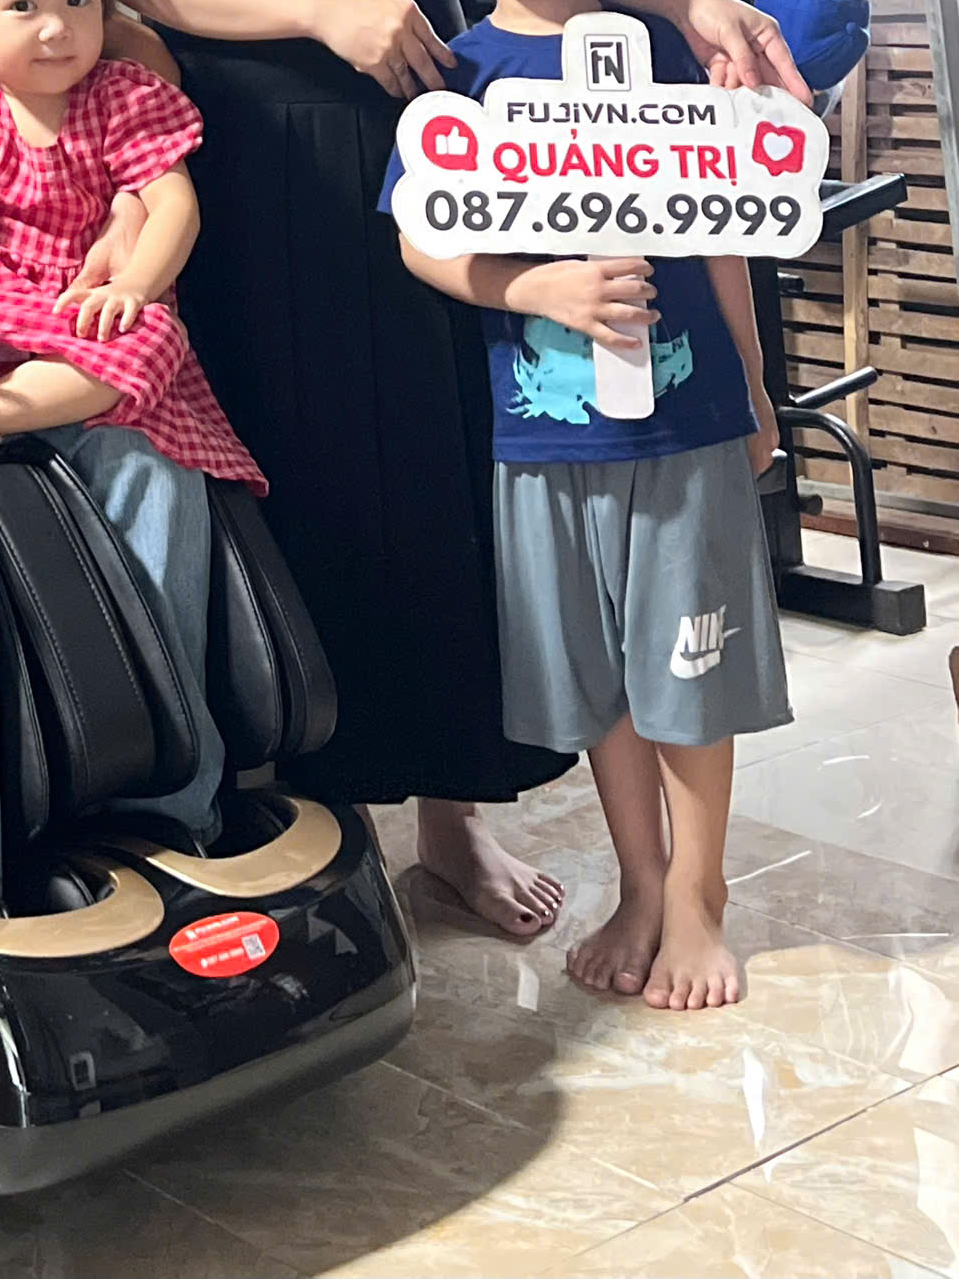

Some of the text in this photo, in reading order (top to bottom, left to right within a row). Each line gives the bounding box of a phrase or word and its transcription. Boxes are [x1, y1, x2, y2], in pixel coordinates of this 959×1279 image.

[492, 128, 738, 186] QUẢNG TRỊ
[425, 189, 802, 236] 087.696.9999
